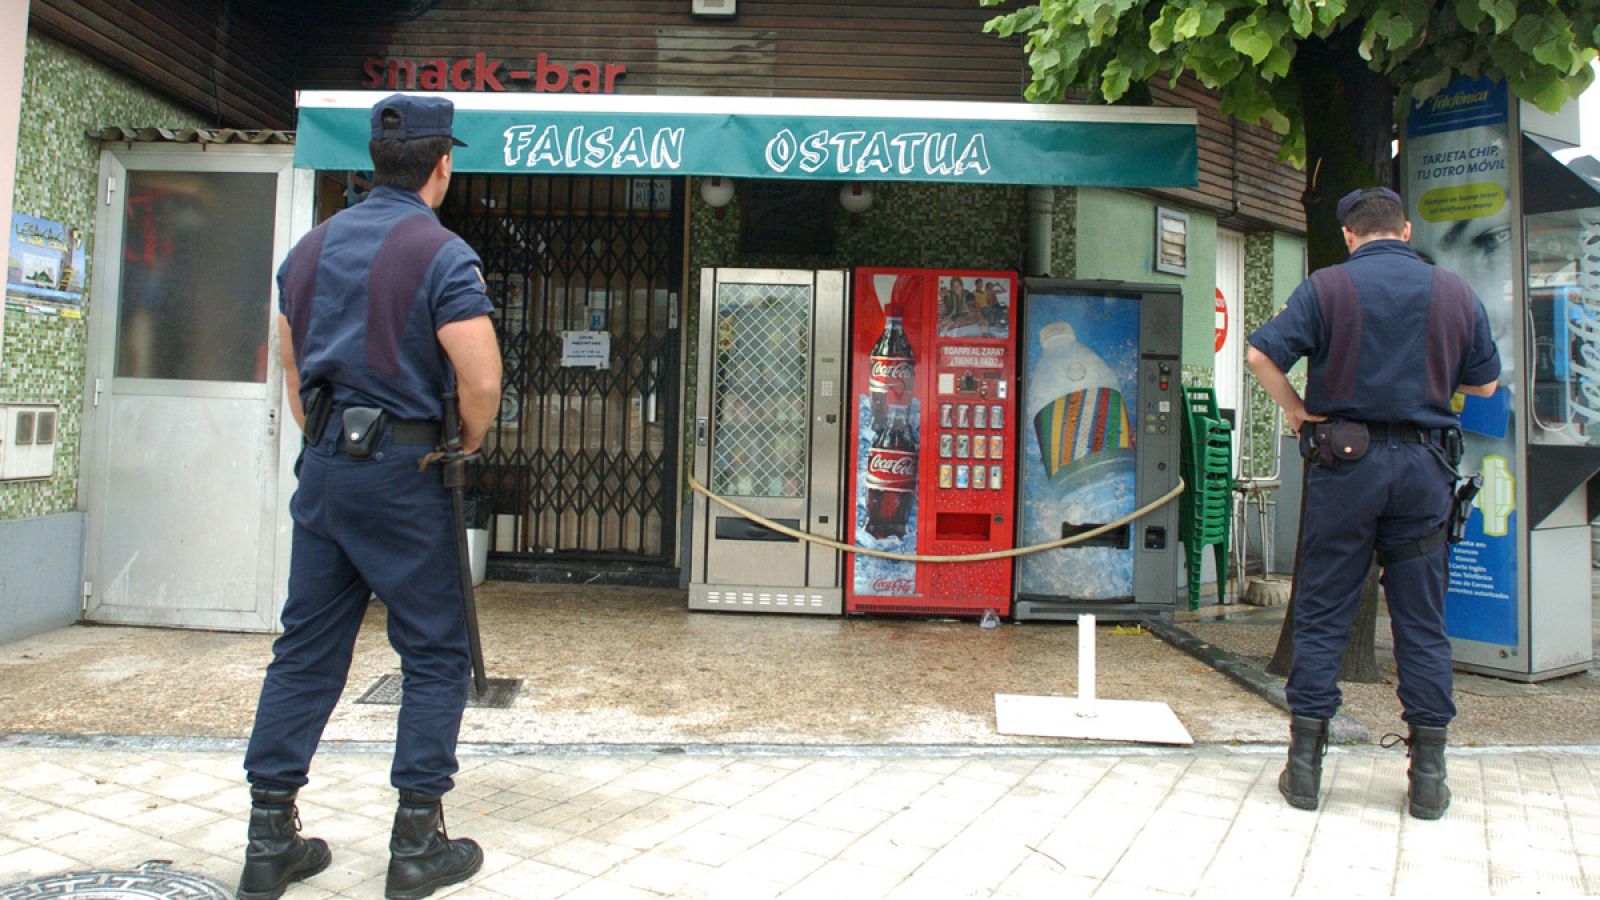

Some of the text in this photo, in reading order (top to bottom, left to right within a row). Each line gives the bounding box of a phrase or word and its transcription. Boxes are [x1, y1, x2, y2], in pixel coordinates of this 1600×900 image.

[361, 52, 626, 93] snack-bar
[503, 124, 991, 175] FAISAN OSTATUA
[1423, 145, 1499, 165] TARJETA CHIP,
[1416, 159, 1505, 180] TU OTRO MÓVIL
